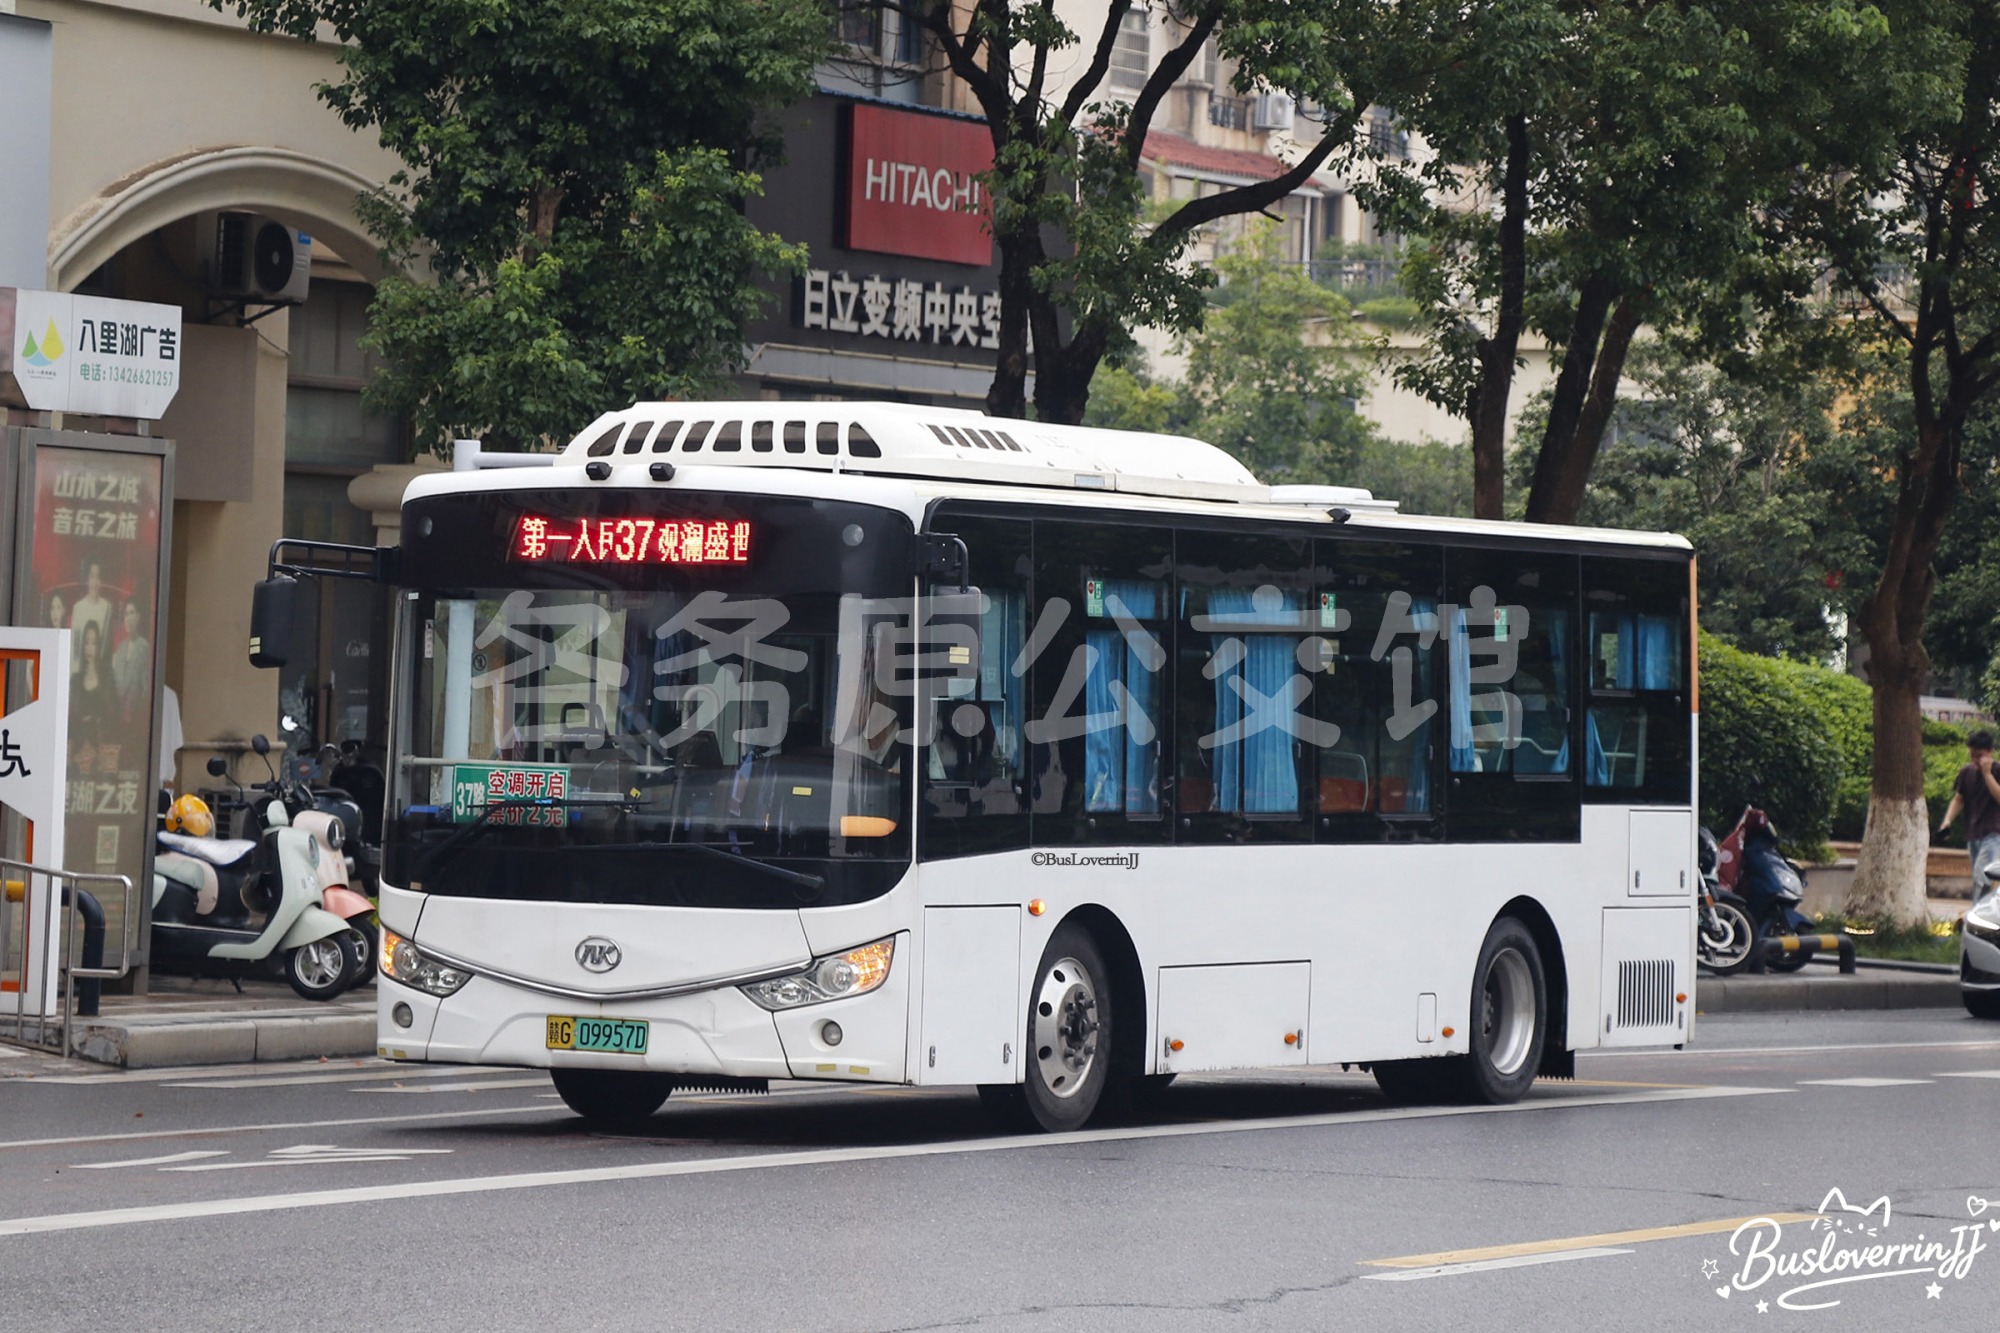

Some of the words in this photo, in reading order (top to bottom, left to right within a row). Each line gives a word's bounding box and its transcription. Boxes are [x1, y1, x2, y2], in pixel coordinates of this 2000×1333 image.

[865, 157, 980, 216] HITACHI
[803, 268, 1001, 350] 日立变频中央空
[79, 318, 177, 361] 八里湖广告
[53, 470, 140, 504] 山水之城
[52, 506, 138, 541] 音乐之旅
[487, 768, 565, 798] 空调开启
[579, 1022, 647, 1049] 09957D
